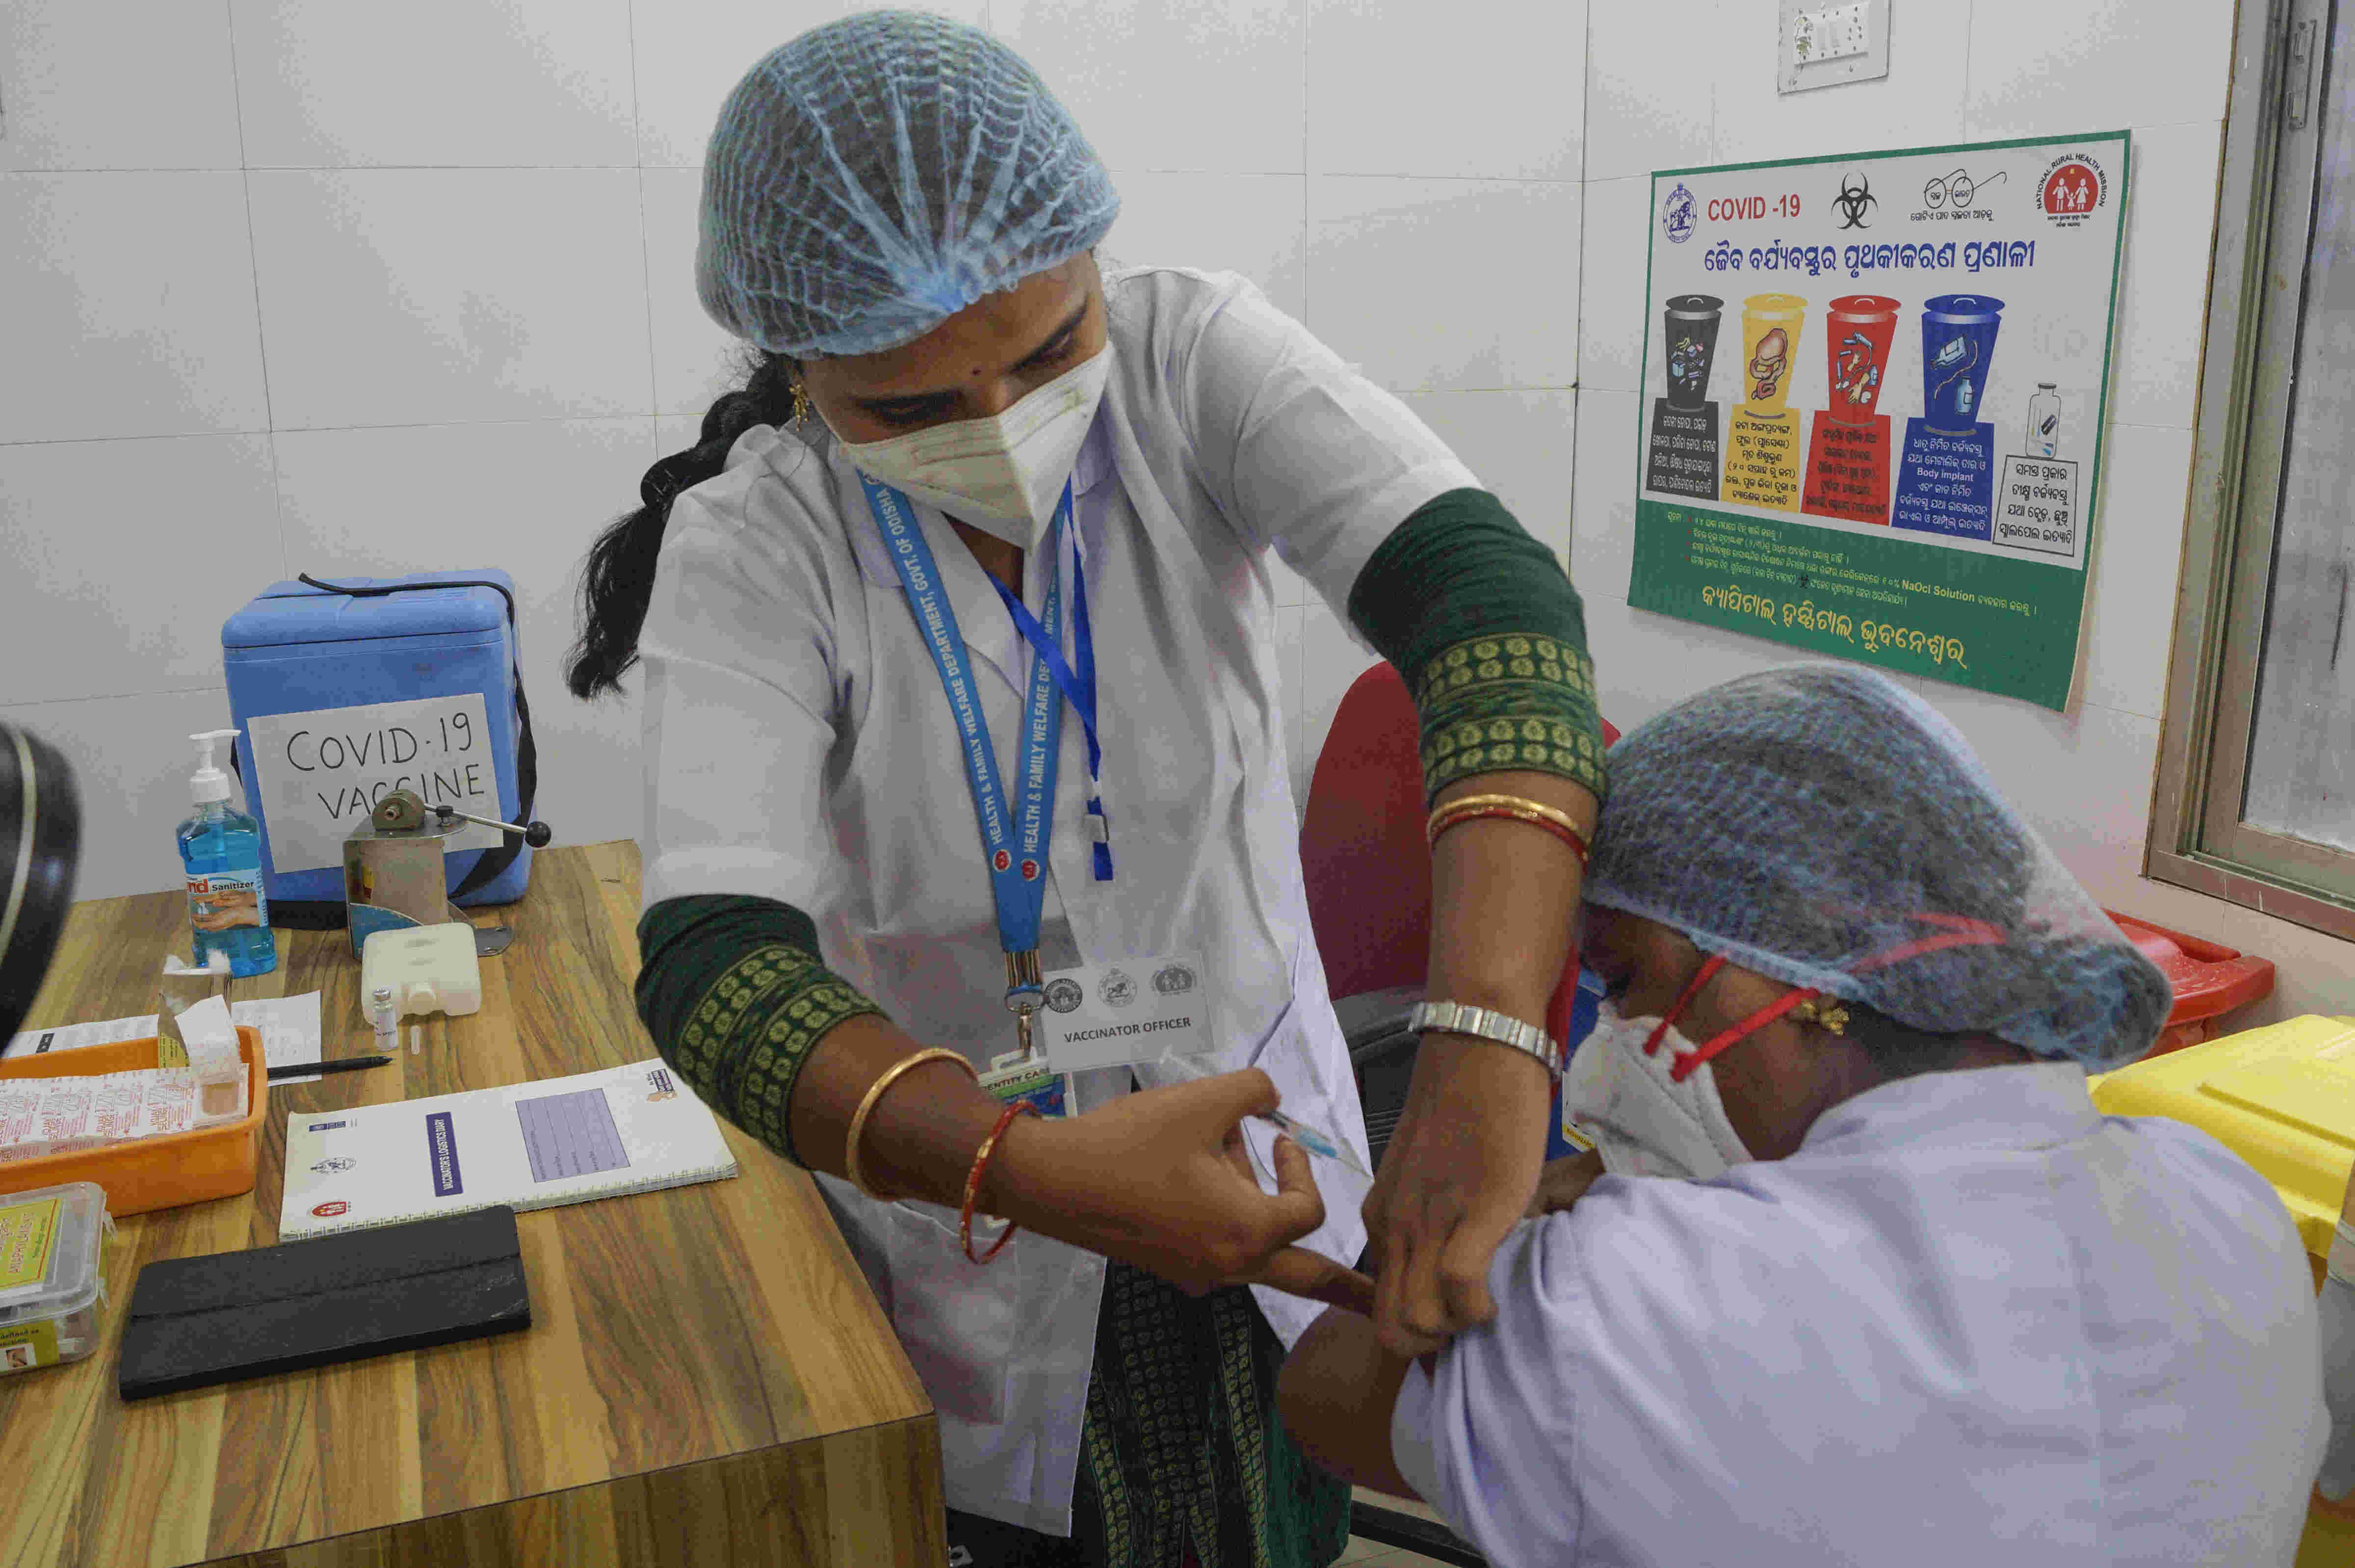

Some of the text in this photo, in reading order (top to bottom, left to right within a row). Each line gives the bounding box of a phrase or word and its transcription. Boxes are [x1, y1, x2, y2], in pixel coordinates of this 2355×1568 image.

[2037, 153, 2108, 209] NATIONAL RURAL HEALTH MISSION
[1707, 196, 1766, 221] COVID
[1772, 193, 1801, 218] -19
[1704, 239, 1743, 271] ଜୈବ
[1963, 240, 2036, 272] ପ୍ରଣାଳୀ
[1917, 467, 1939, 479] Body
[875, 488, 905, 536] ODISHA
[894, 538, 913, 554] OF
[1934, 585, 1975, 603] Solution
[952, 678, 977, 736] WELFARE
[1032, 684, 1050, 742] WELFARE
[969, 738, 989, 782] FAMILY
[1028, 746, 1045, 789] FAMILY
[317, 763, 485, 820] VACINE
[981, 782, 992, 793] &
[1027, 792, 1043, 801] &
[984, 795, 1003, 845] HEALTH
[1024, 804, 1041, 853] HEALTH
[188, 879, 255, 894] nd Sanitizer
[1063, 1016, 1192, 1044] VACCINATOR OFFICER
[435, 1118, 446, 1132] DIARY
[436, 1131, 449, 1156] LOGISTICS
